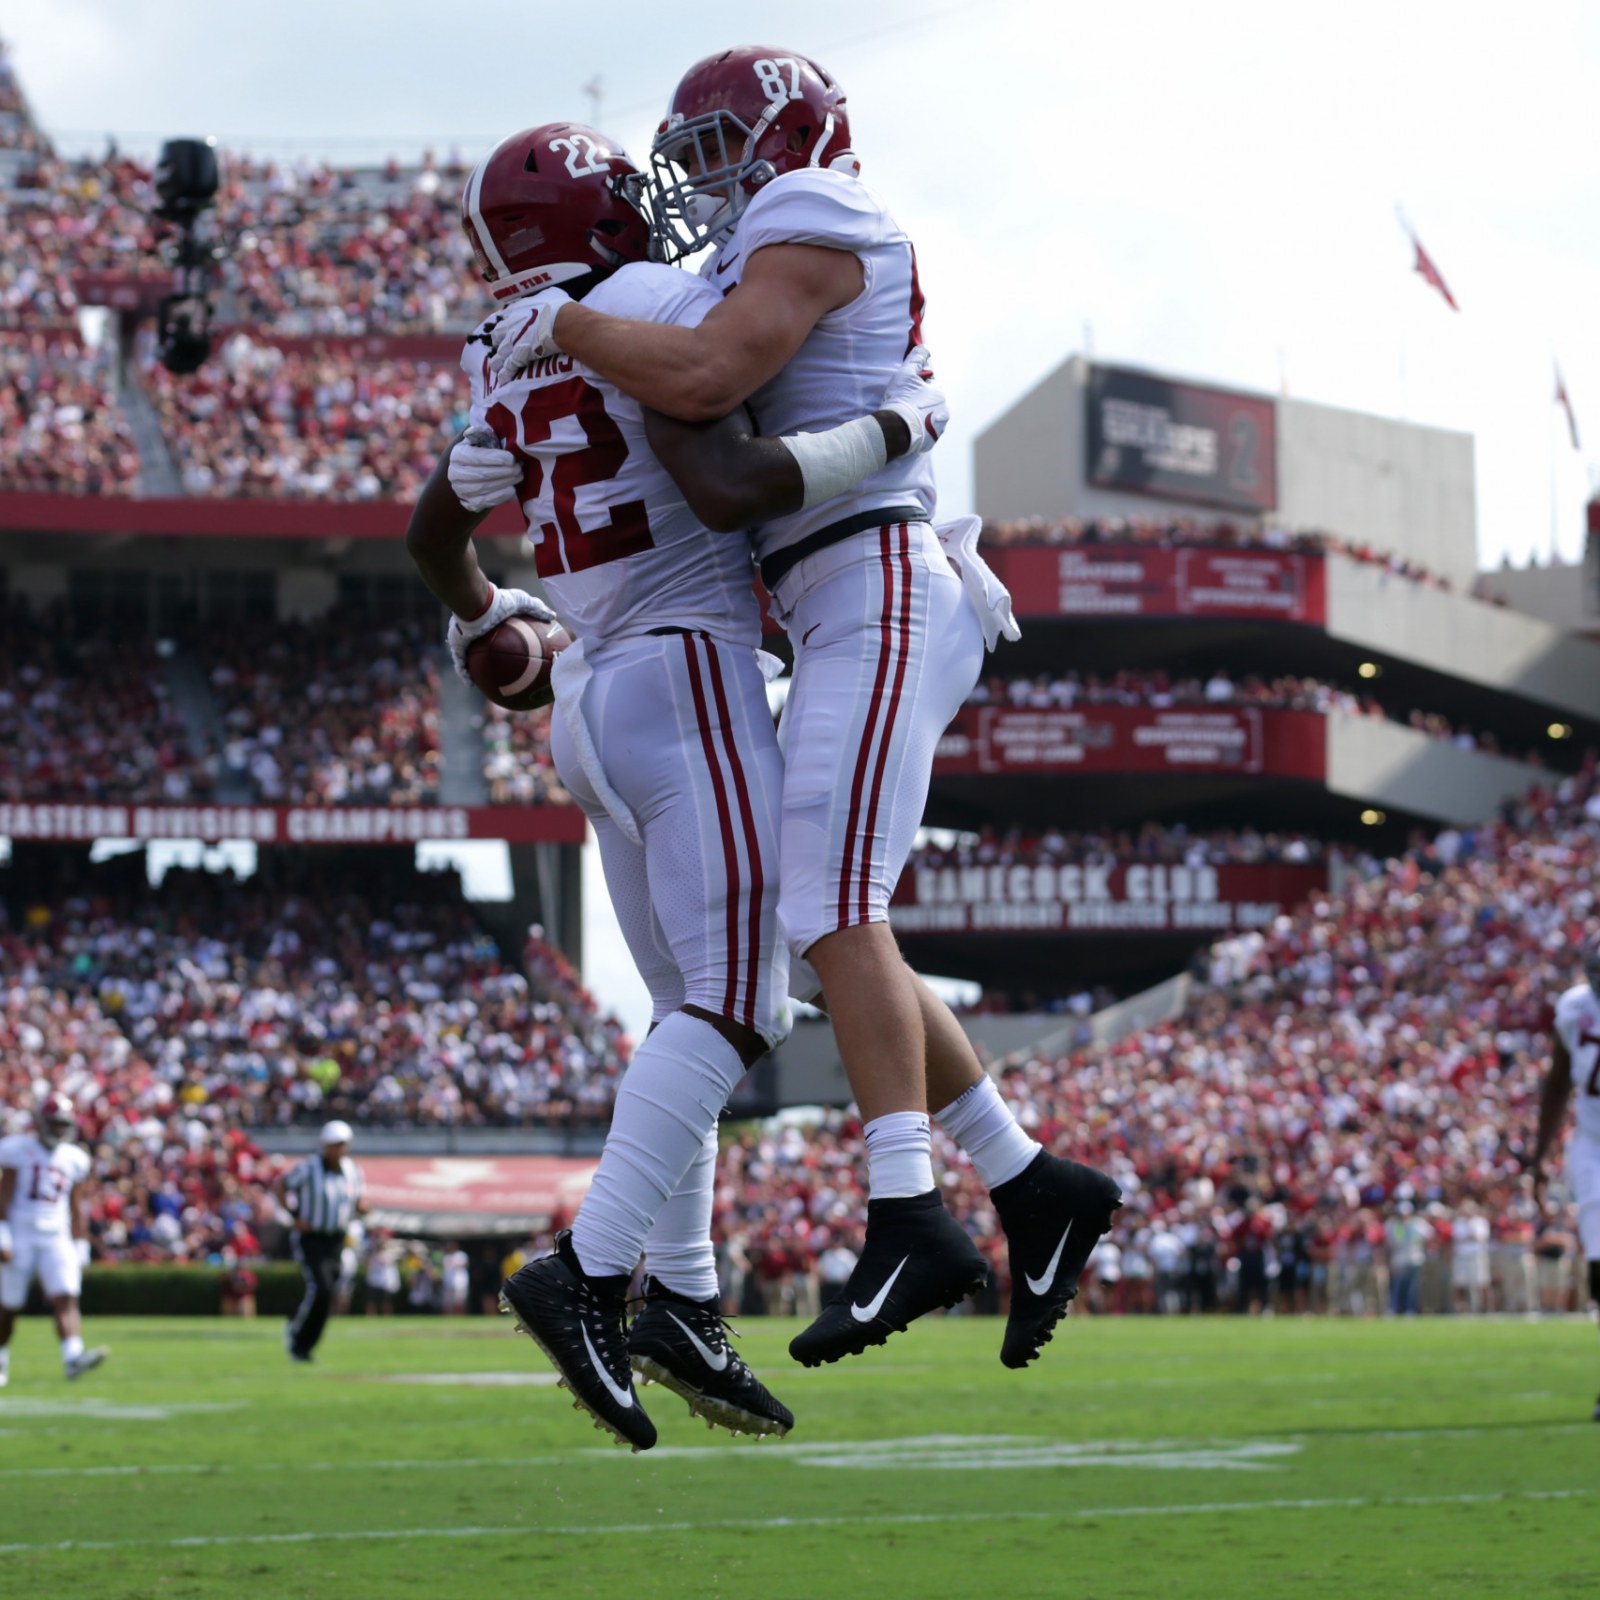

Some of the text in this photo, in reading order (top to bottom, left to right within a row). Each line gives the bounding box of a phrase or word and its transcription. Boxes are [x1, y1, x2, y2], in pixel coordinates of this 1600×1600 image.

[753, 58, 804, 101] 87
[548, 134, 611, 179] 22
[519, 272, 552, 289] TIDE
[485, 375, 656, 579] 22
[0, 804, 469, 841] EASTERN DIVISION CHAMPIONS
[917, 865, 1218, 901] GAMECOCK CLUB
